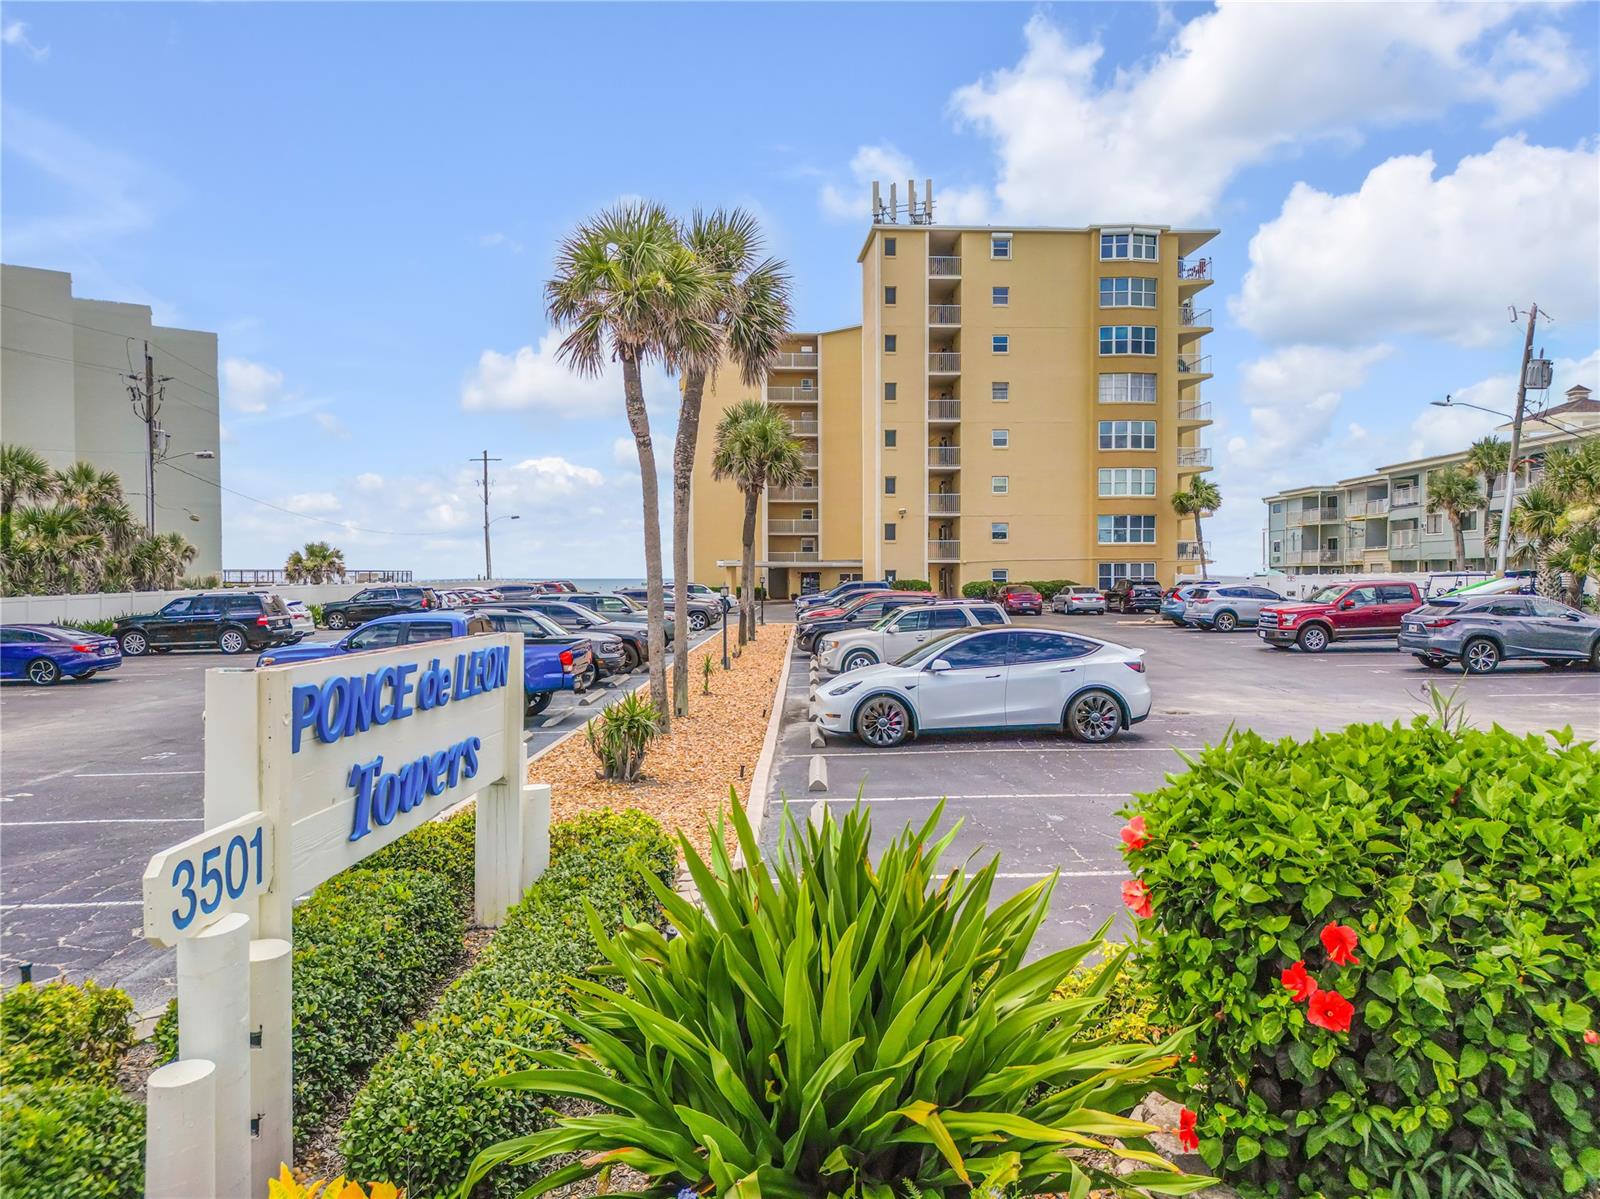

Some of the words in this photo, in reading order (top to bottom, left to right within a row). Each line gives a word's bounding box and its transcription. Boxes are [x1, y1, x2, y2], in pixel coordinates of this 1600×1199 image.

[291, 662, 418, 754] PONCE
[419, 658, 452, 711] de
[452, 645, 511, 702] LEON
[348, 735, 481, 842] Towers
[171, 826, 264, 931] 3501
